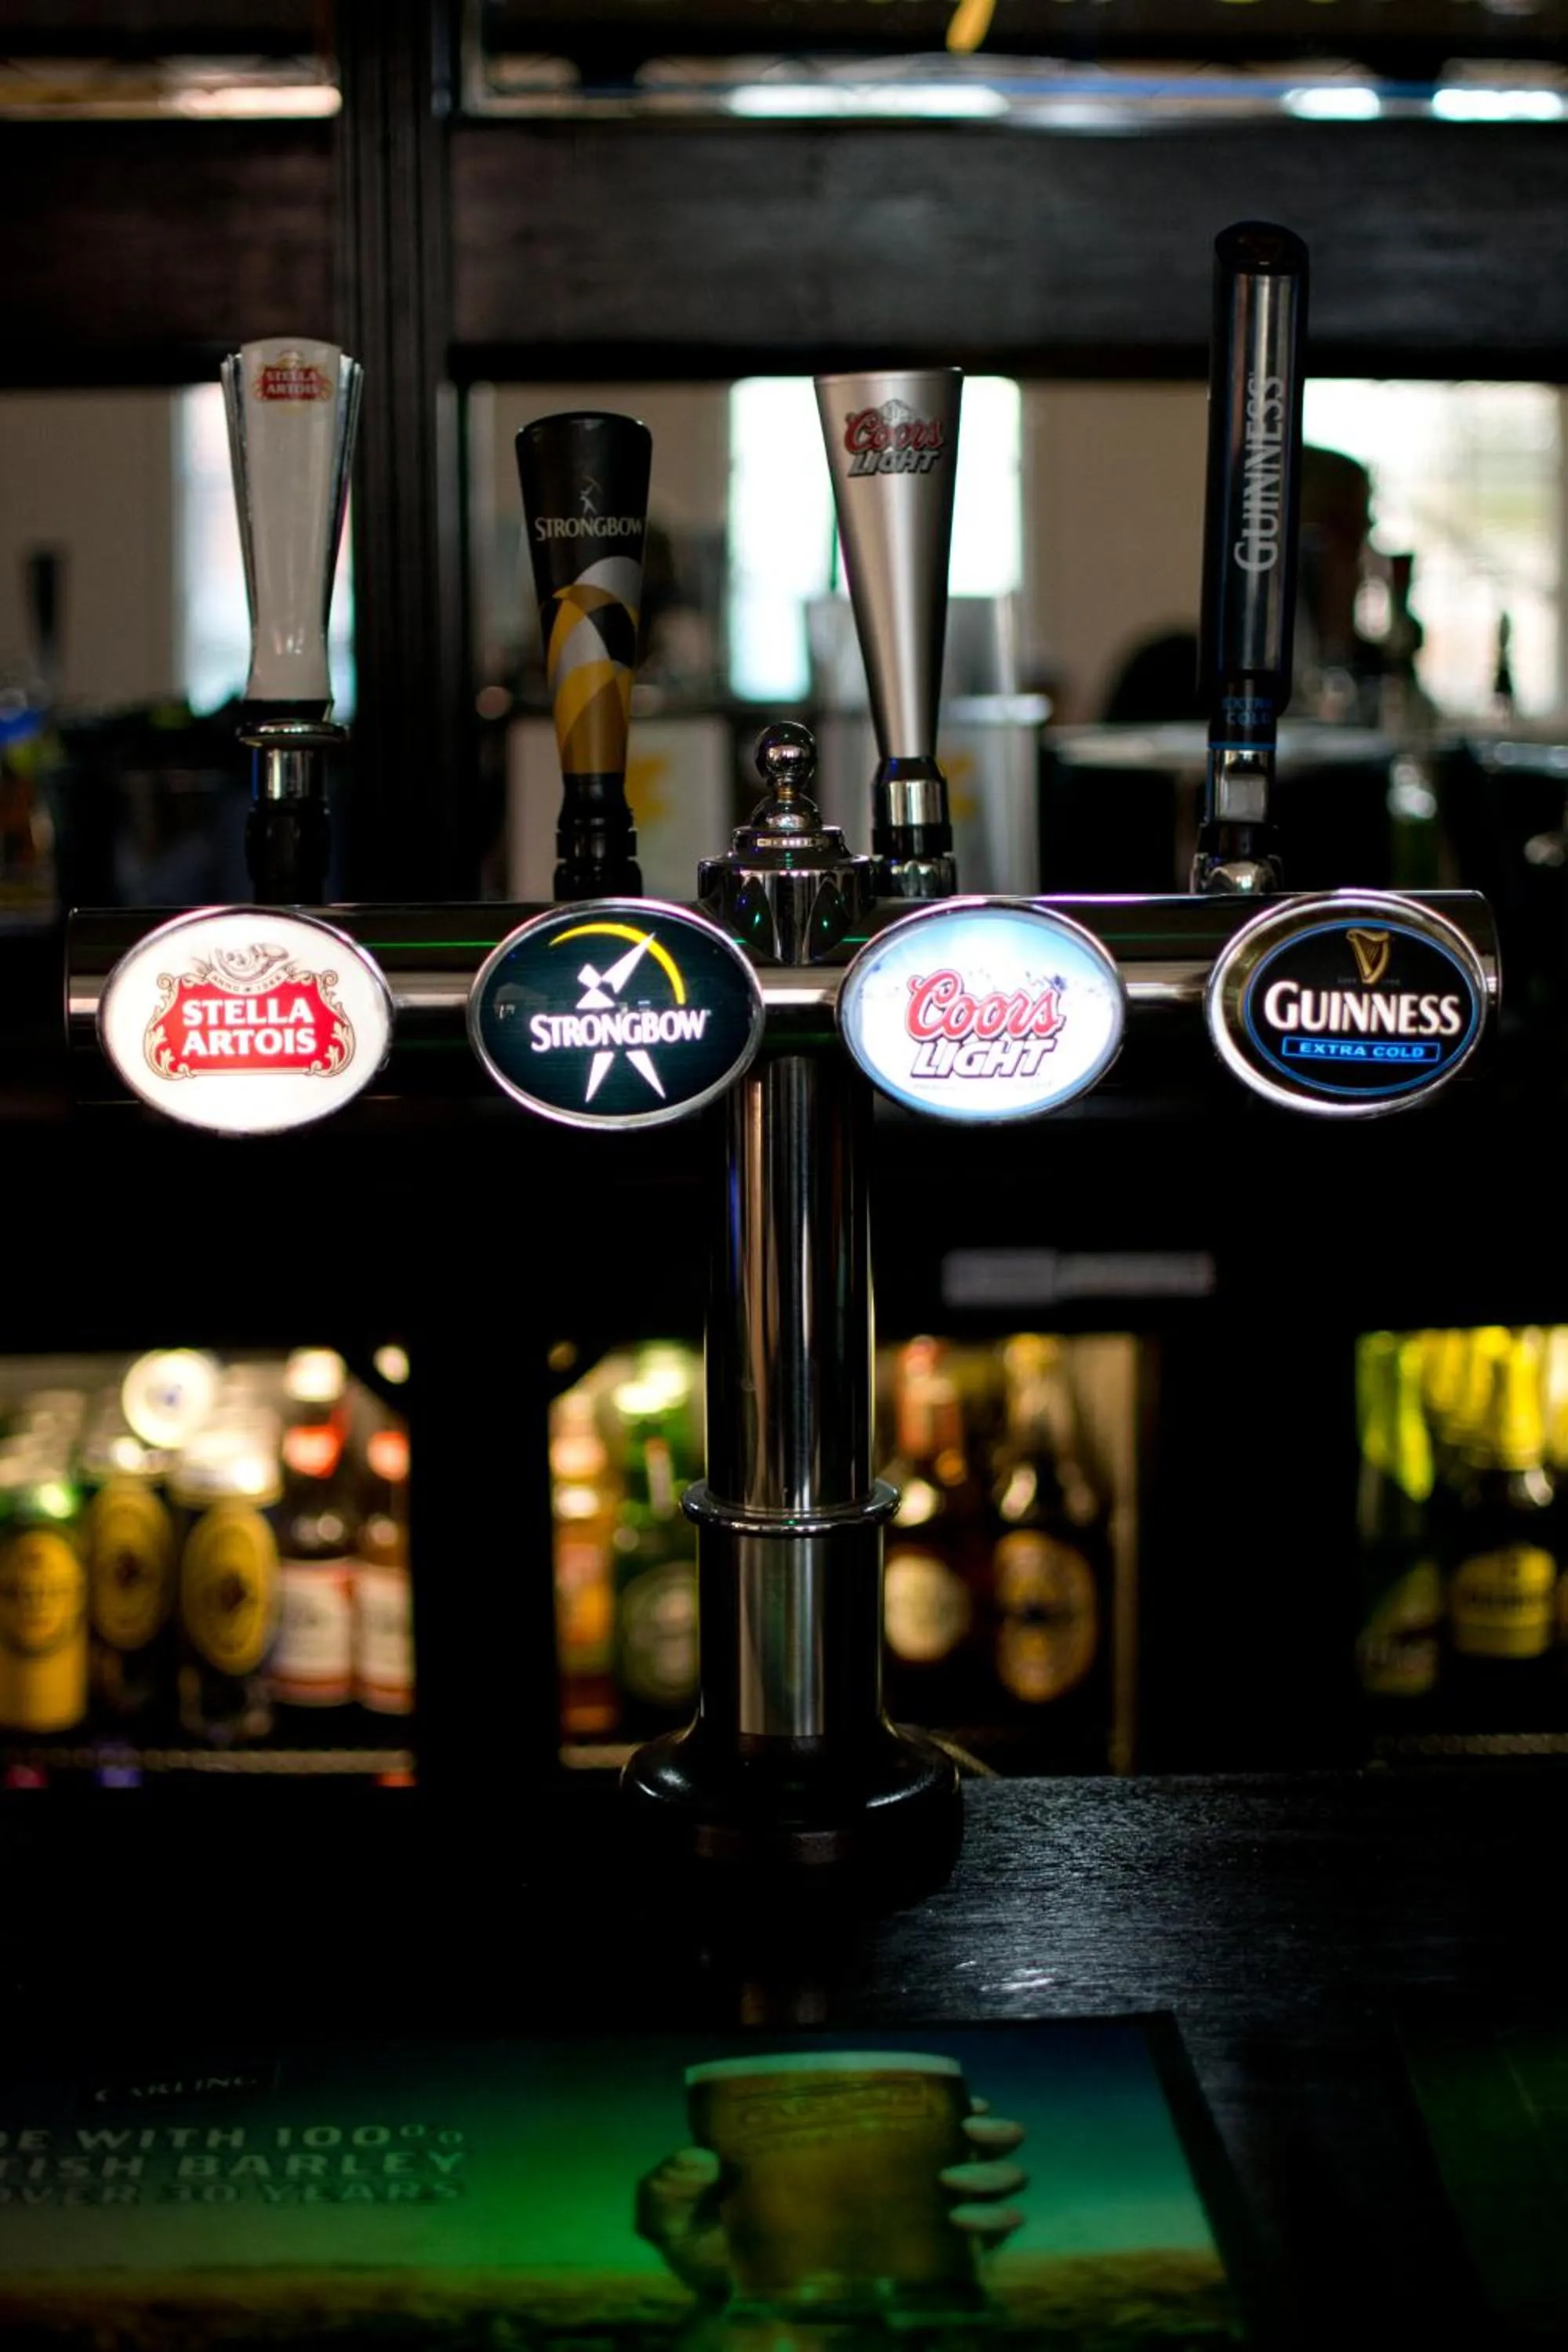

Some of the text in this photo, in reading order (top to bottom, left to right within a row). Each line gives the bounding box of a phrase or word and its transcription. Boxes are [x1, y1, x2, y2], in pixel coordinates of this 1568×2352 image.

[266, 370, 317, 382] STELLA
[267, 383, 320, 395] ARTOIS
[844, 408, 945, 455] Coors
[848, 449, 941, 477] LIGHT
[1233, 376, 1285, 572] GUINNESS
[534, 516, 643, 542] STRONGBOW
[181, 997, 314, 1025] STELLA
[906, 969, 1065, 1042] Coors
[1264, 980, 1461, 1035] GUINNESS
[181, 1028, 317, 1056] ARTOIS
[529, 1008, 707, 1052] STRONGBOW
[909, 1038, 1058, 1079] LIGHT
[1298, 1041, 1425, 1058] EXTRA COLD
[77, 2126, 246, 2151] WITH
[275, 2123, 466, 2150] 100%
[177, 2151, 465, 2179] BARLEY
